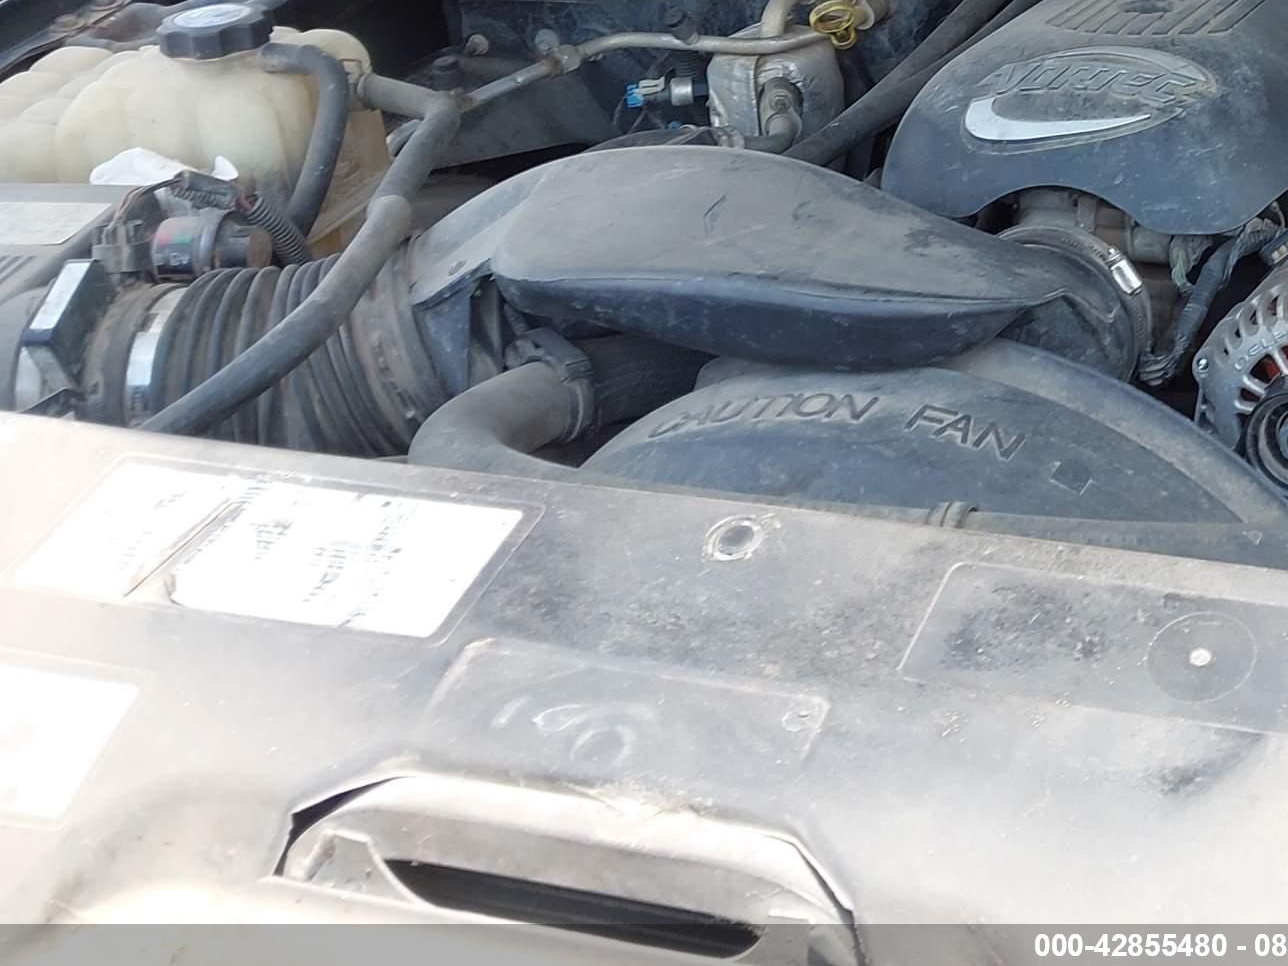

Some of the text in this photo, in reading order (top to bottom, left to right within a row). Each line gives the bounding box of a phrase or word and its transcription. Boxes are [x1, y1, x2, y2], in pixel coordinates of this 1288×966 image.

[977, 63, 1198, 107] VORTEC
[650, 393, 1026, 461] CAUTION FAN
